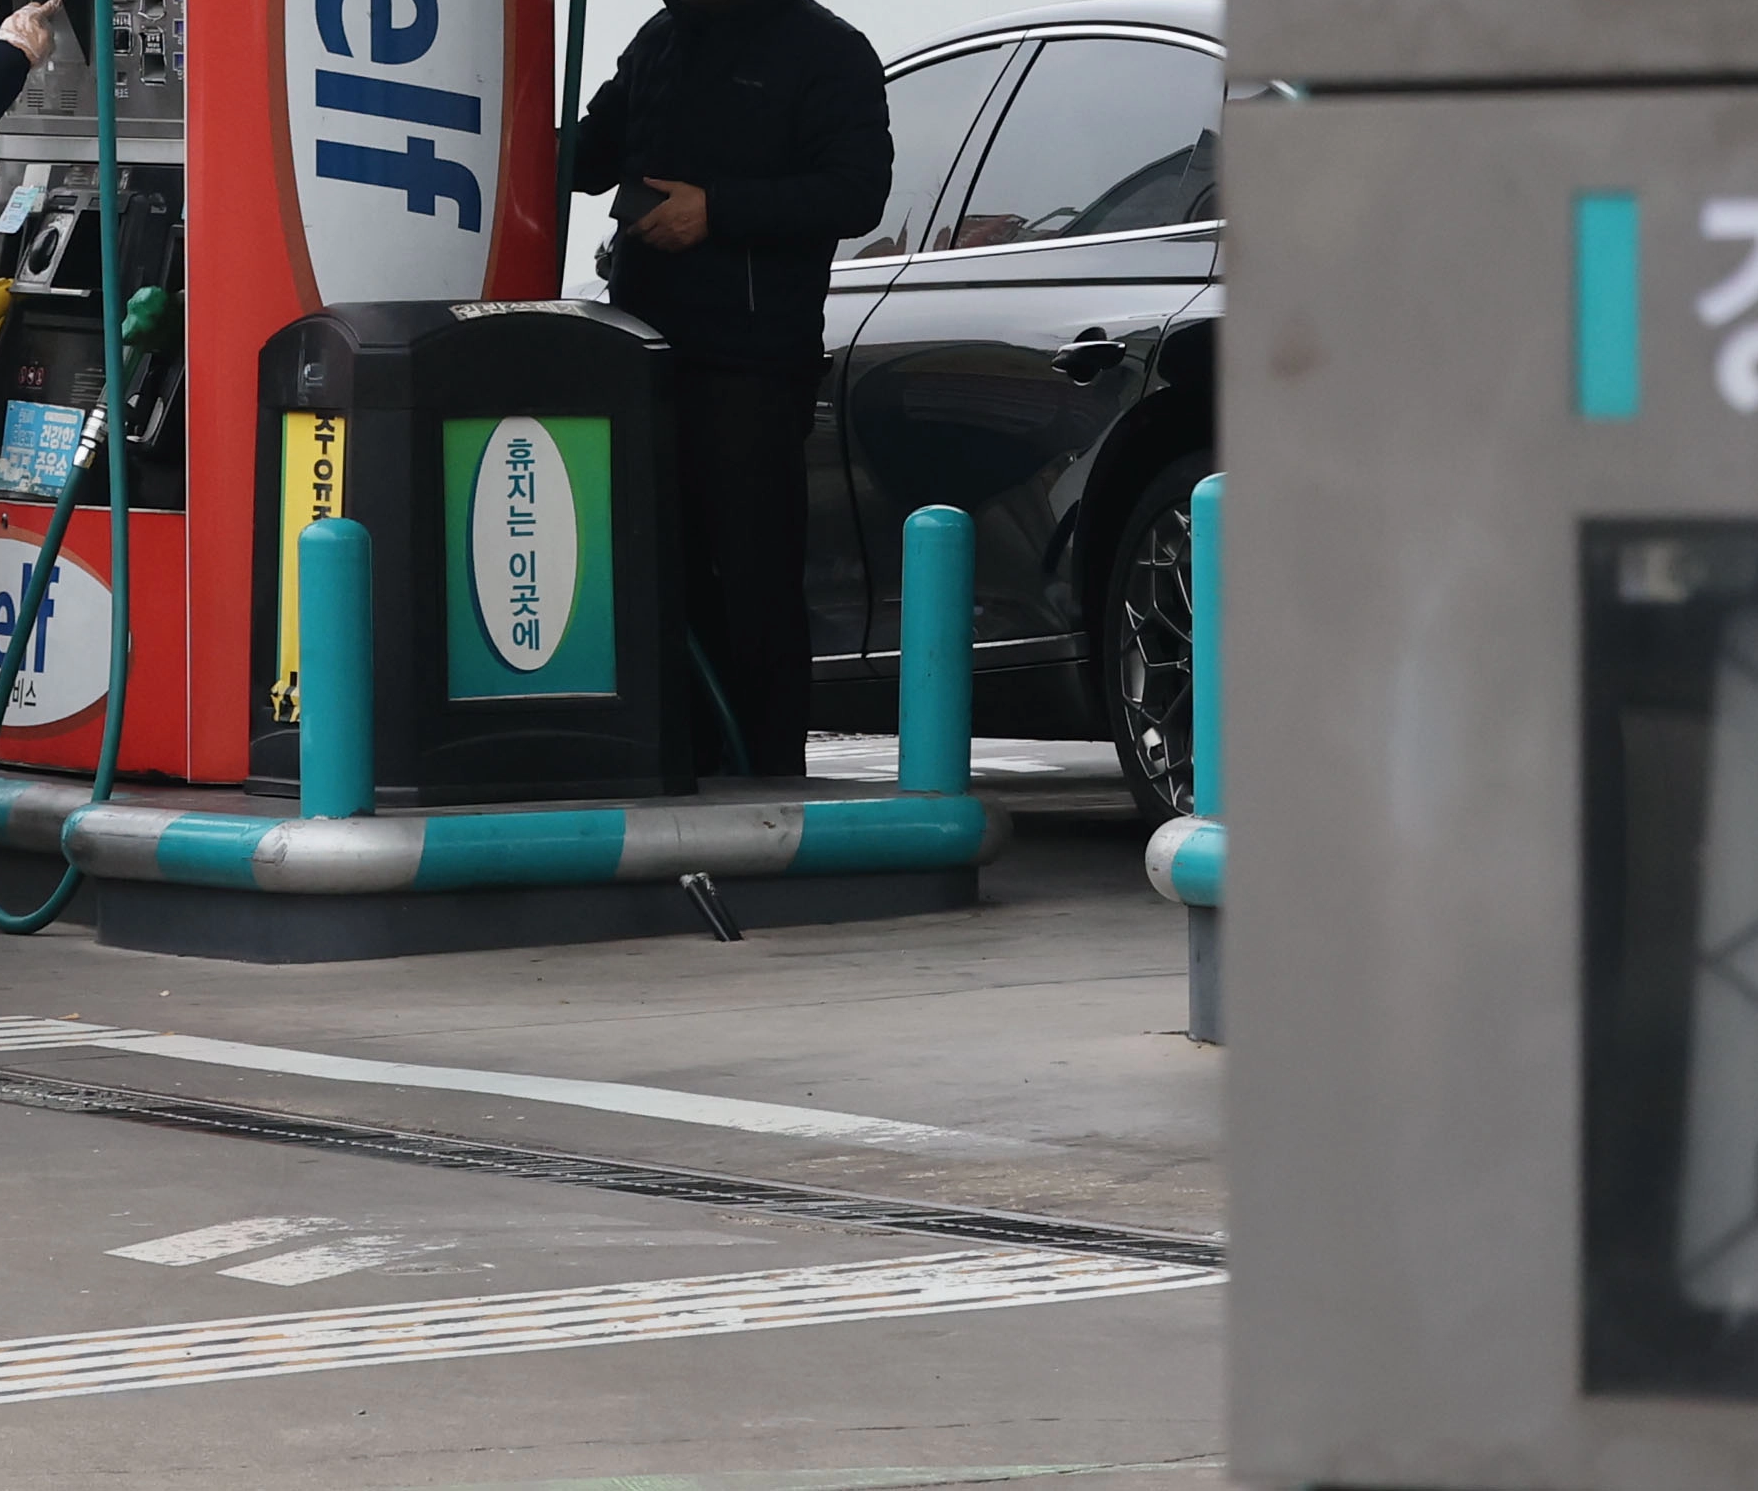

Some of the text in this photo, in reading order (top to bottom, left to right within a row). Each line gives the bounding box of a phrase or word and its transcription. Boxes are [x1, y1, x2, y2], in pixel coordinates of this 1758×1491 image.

[39, 423, 76, 450] 건강한
[33, 450, 69, 480] 주유소
[505, 438, 540, 651] 휴지는 이곳에
